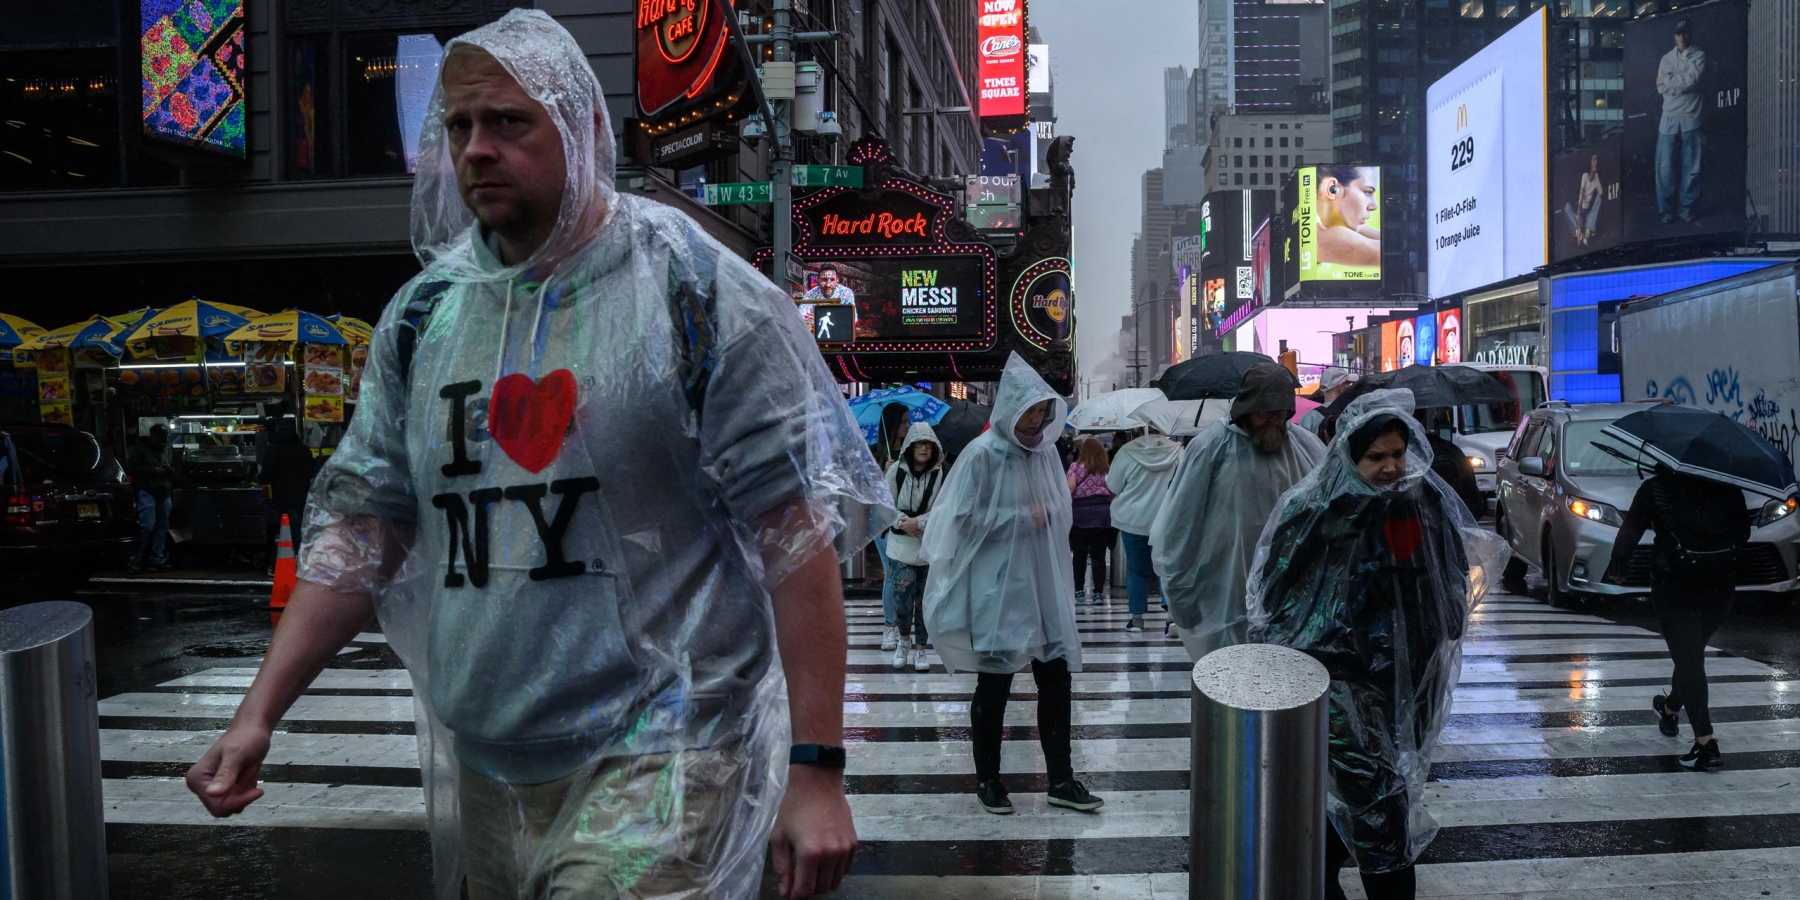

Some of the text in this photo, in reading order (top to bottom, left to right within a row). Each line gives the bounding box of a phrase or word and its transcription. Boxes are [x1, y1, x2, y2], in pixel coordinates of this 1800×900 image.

[984, 0, 1015, 13] NOW
[668, 15, 693, 42] CAFE
[982, 13, 1017, 27] OPEN
[982, 35, 1020, 56] Cane's
[984, 77, 1016, 88] TIMES
[981, 87, 1020, 99] SQUARE
[1717, 88, 1740, 108] GAP
[661, 132, 703, 157] SPECTACOLOR
[1451, 136, 1474, 171] 229
[823, 168, 849, 183] 7 Av
[720, 184, 769, 202] W 43 St
[1607, 182, 1619, 201] GAP
[1435, 195, 1477, 225] 1 Filet-O-Fish
[822, 212, 927, 238] Hard Rock
[1301, 206, 1311, 247] TONE
[1177, 237, 1199, 250] LITTLE
[1435, 224, 1481, 251] 1 Orange Juice
[1301, 251, 1311, 270] LG
[902, 269, 938, 287] NEW
[902, 287, 957, 306] MESSI
[1033, 295, 1058, 308] Hard
[927, 306, 957, 314] SANDWICH
[146, 317, 193, 331] SABRETT
[246, 321, 294, 332] SABRETT
[1498, 345, 1530, 366] NAVY
[439, 379, 482, 478] I
[431, 476, 600, 588] NY
